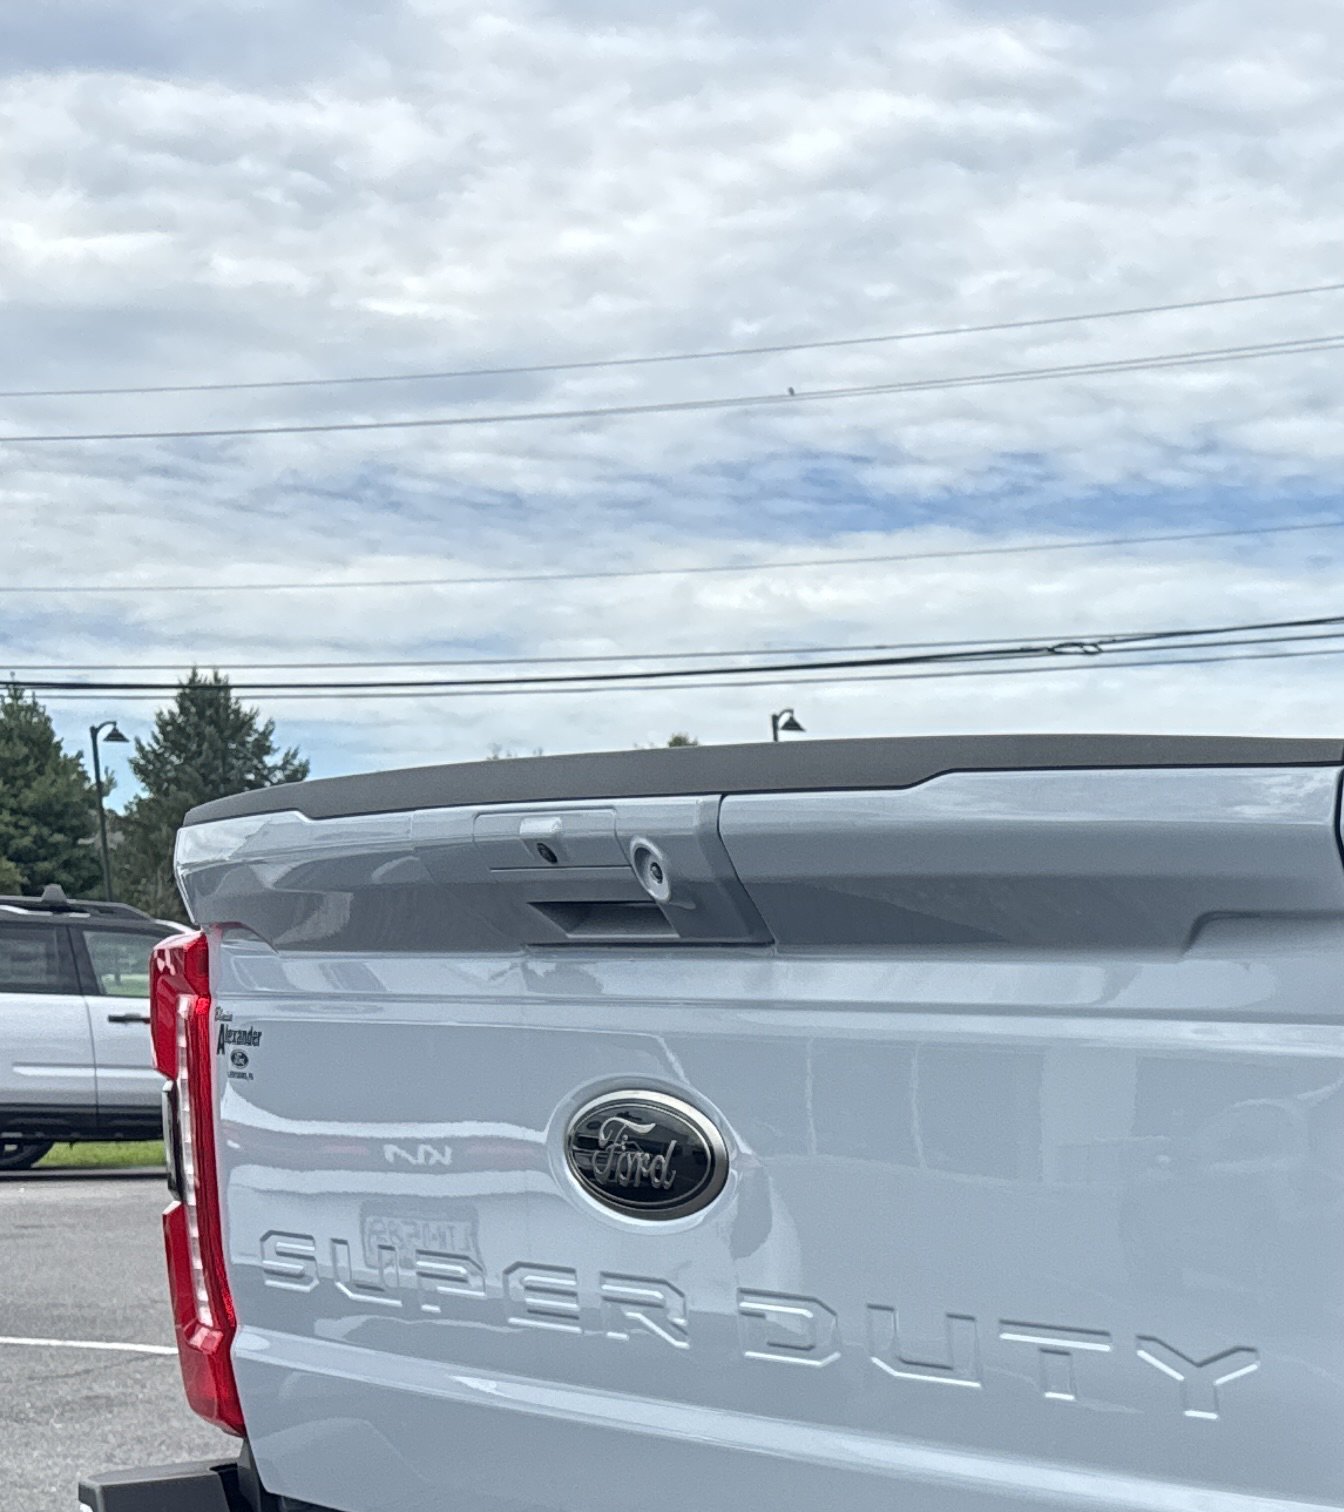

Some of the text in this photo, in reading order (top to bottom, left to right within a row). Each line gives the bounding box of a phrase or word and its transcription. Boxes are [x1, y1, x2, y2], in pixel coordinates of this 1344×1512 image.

[592, 1116, 678, 1190] Ford
[259, 1229, 1261, 1420] SUPER DUTY
